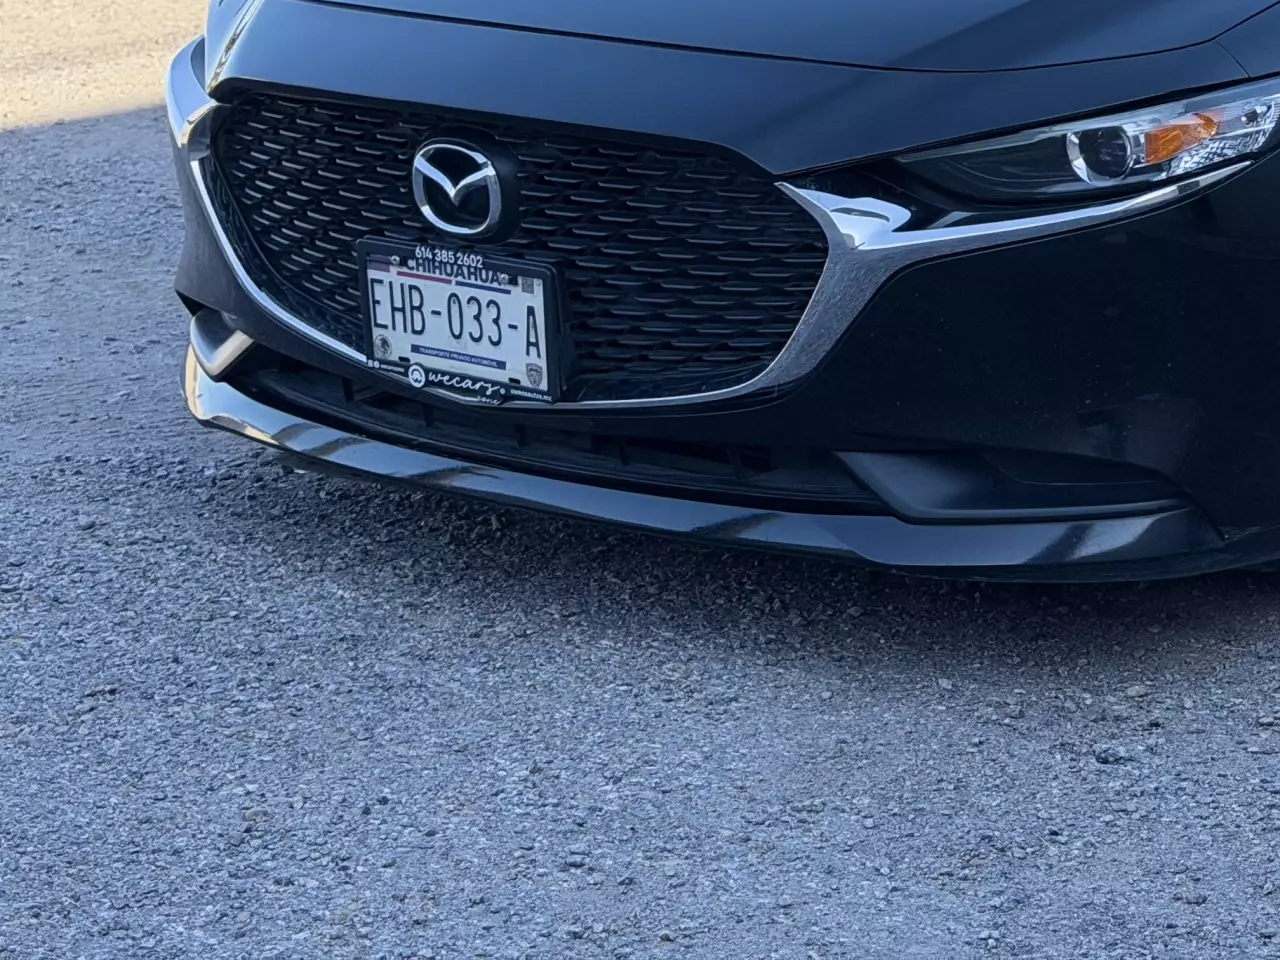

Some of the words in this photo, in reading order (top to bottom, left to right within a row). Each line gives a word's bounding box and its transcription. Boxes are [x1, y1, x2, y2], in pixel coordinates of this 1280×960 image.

[415, 246, 433, 260] 614
[435, 249, 455, 263] 385
[456, 252, 484, 268] 2602
[370, 277, 542, 359] EHB-033-A
